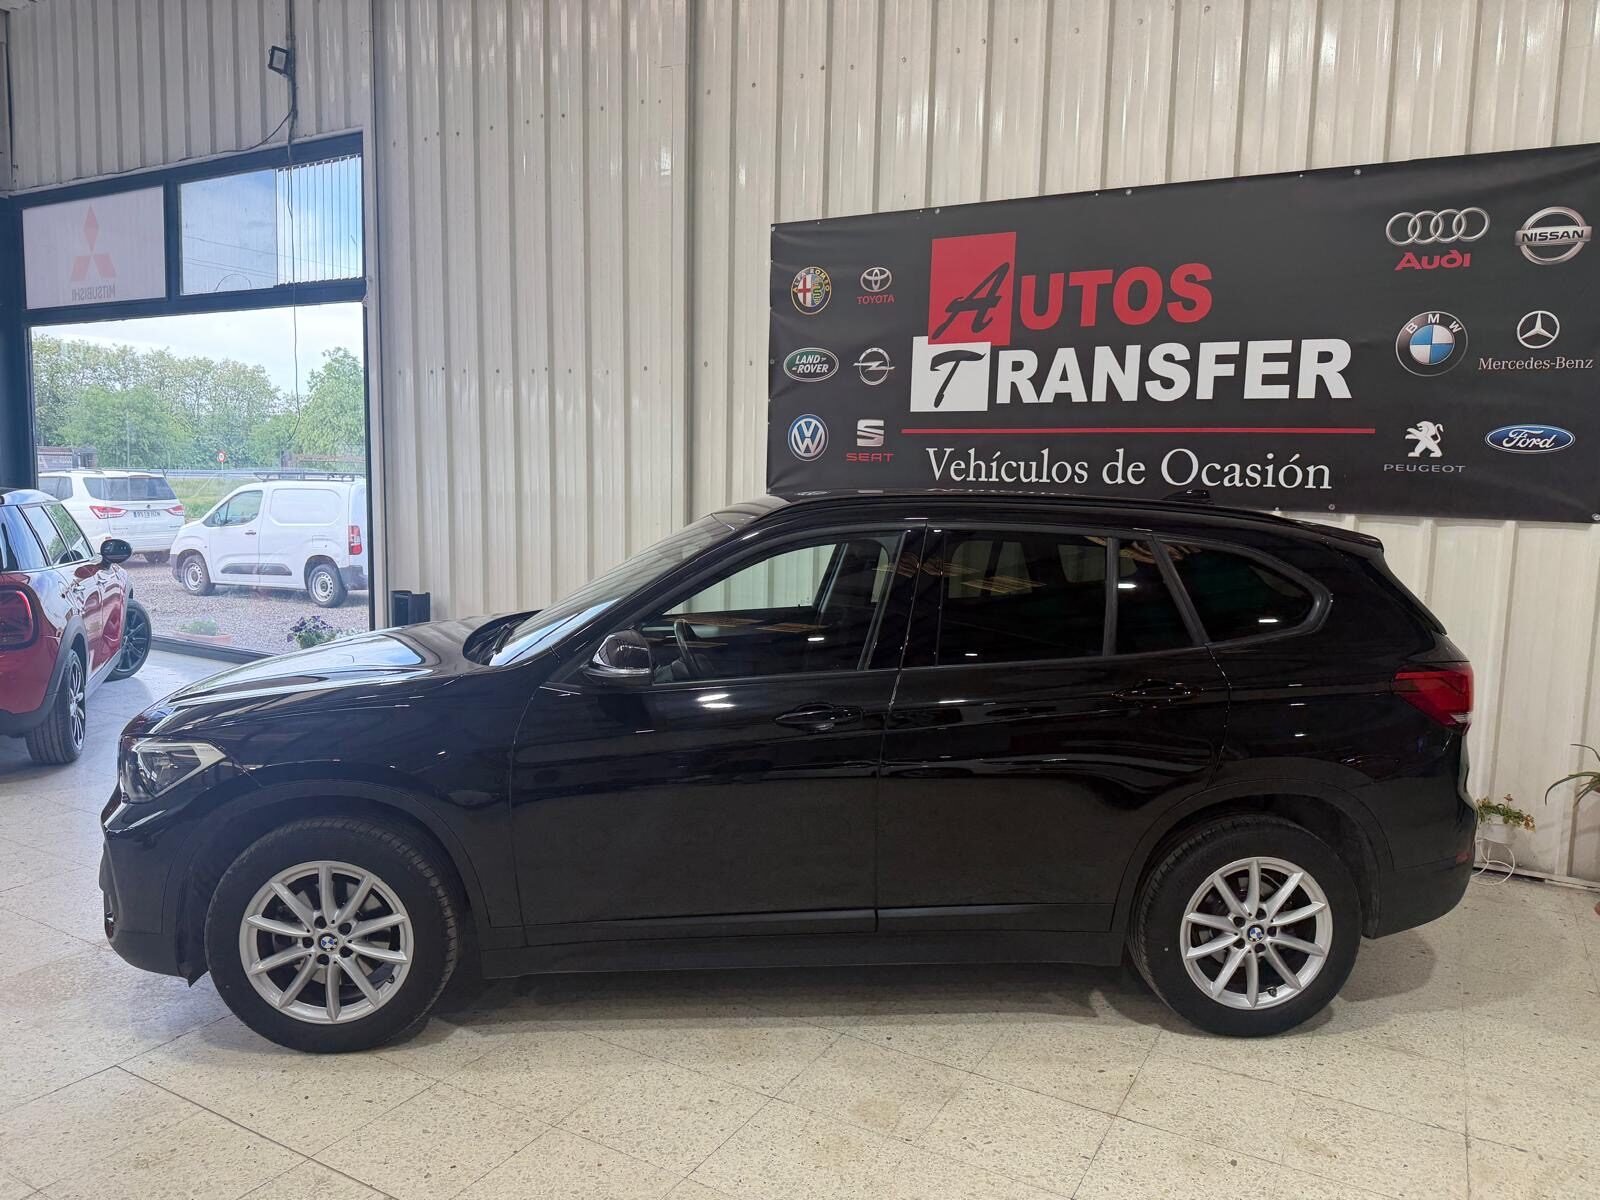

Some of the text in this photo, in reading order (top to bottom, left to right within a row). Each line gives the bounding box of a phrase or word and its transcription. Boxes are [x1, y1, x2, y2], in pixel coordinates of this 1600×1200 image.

[1521, 229, 1584, 243] NISSAN
[1394, 250, 1472, 271] Audi
[856, 294, 896, 305] TOYOTA
[930, 261, 1213, 340] AUTOS
[1405, 312, 1463, 335] BMW
[795, 354, 821, 365] LAND
[1478, 355, 1593, 371] Mercedes-Benz
[797, 363, 829, 374] ROVER
[929, 337, 1353, 409] TRANSFER
[1502, 431, 1555, 449] Ford
[846, 452, 893, 462] SEAT
[926, 446, 1333, 490] Vehículos de Ocasión
[1383, 463, 1466, 473] PEUGEOT
